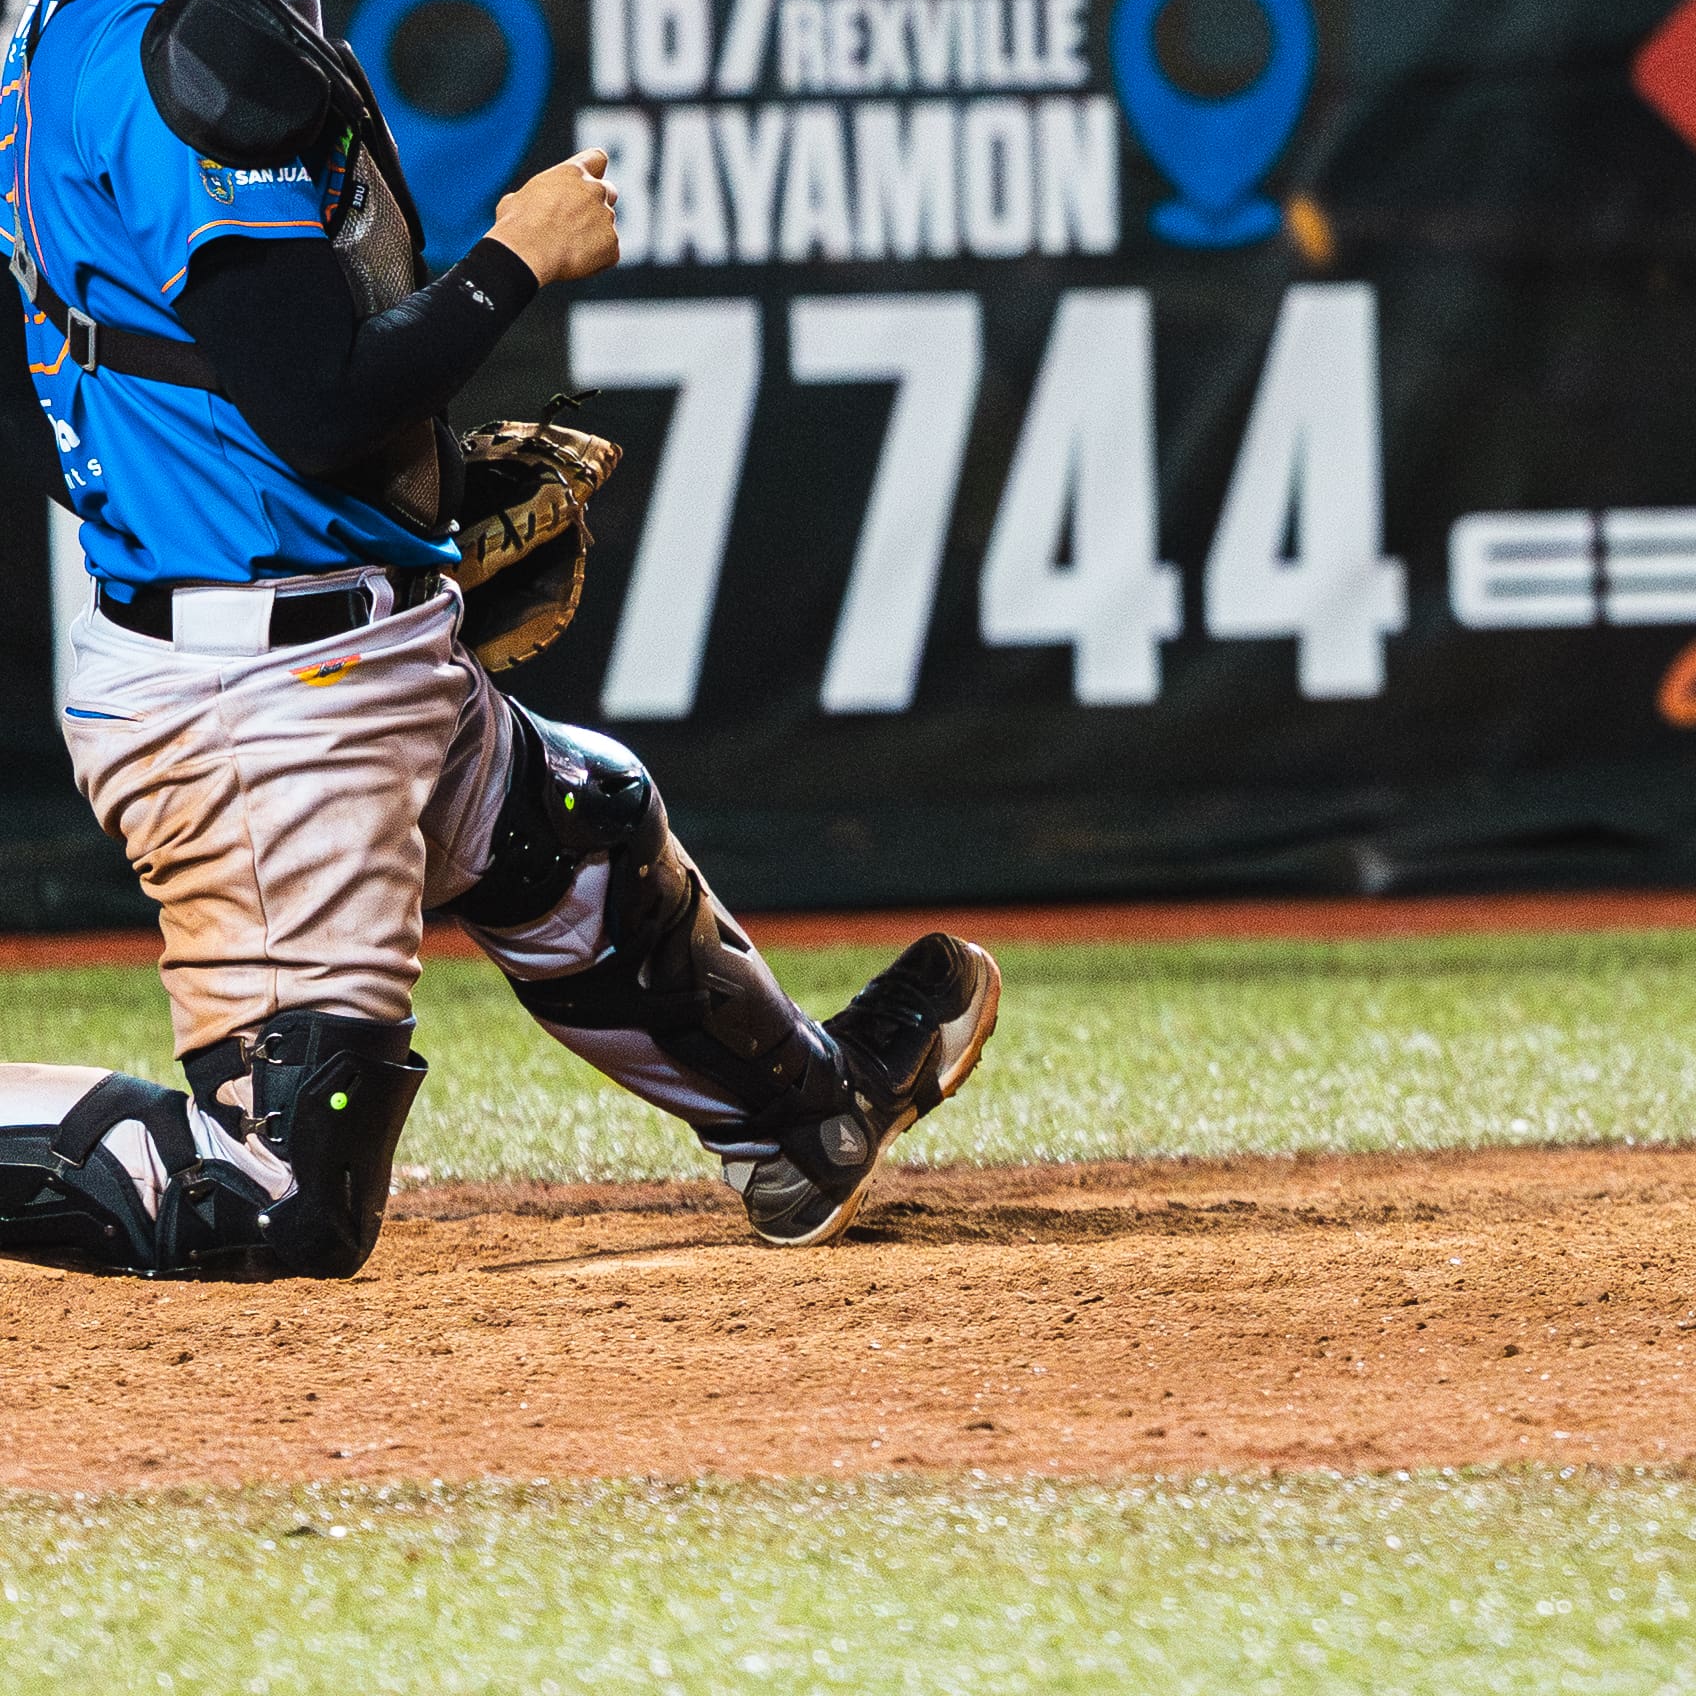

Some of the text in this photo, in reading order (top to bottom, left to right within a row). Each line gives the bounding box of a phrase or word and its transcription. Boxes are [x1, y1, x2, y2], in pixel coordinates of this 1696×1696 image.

[234, 166, 312, 186] SAN JUA
[574, 97, 1122, 266] BAYAMON
[568, 281, 1410, 721] 7744
